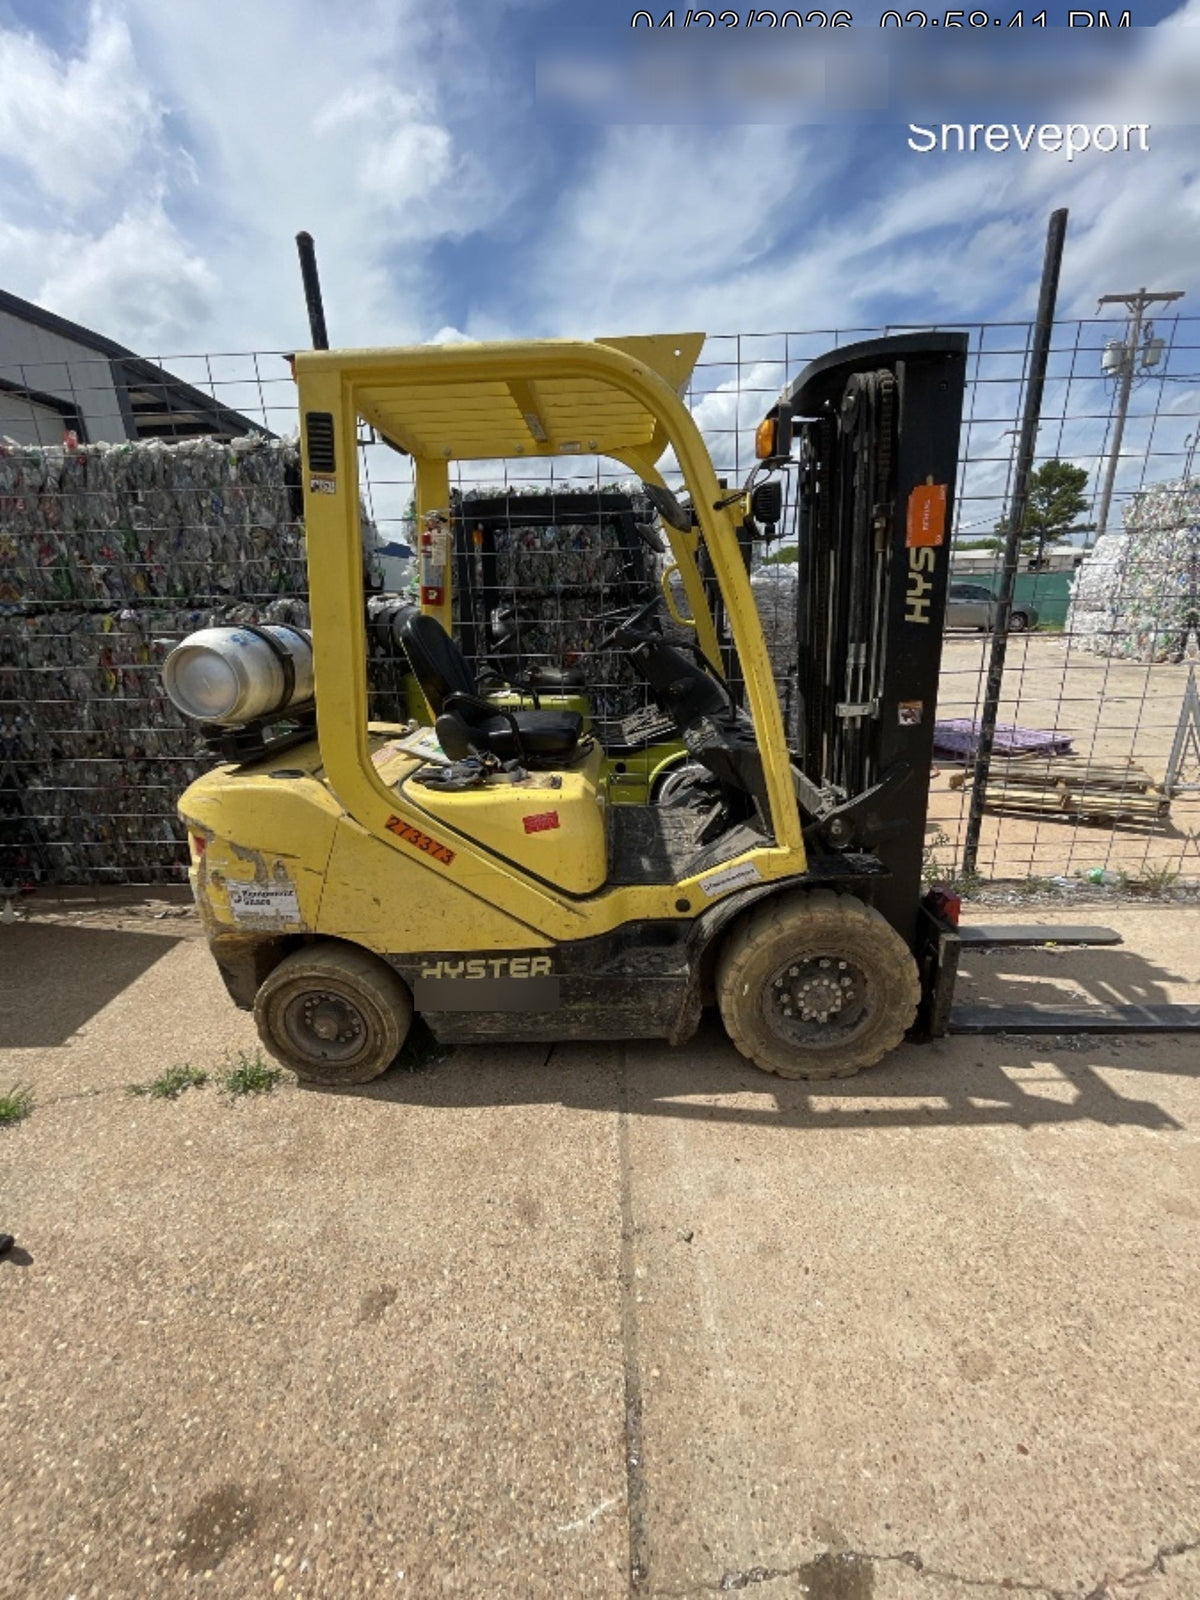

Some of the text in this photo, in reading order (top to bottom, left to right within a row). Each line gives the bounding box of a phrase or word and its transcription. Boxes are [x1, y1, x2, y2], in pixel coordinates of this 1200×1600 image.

[904, 547, 936, 624] HYS
[385, 815, 455, 866] 273373
[421, 955, 552, 979] HYSTER
